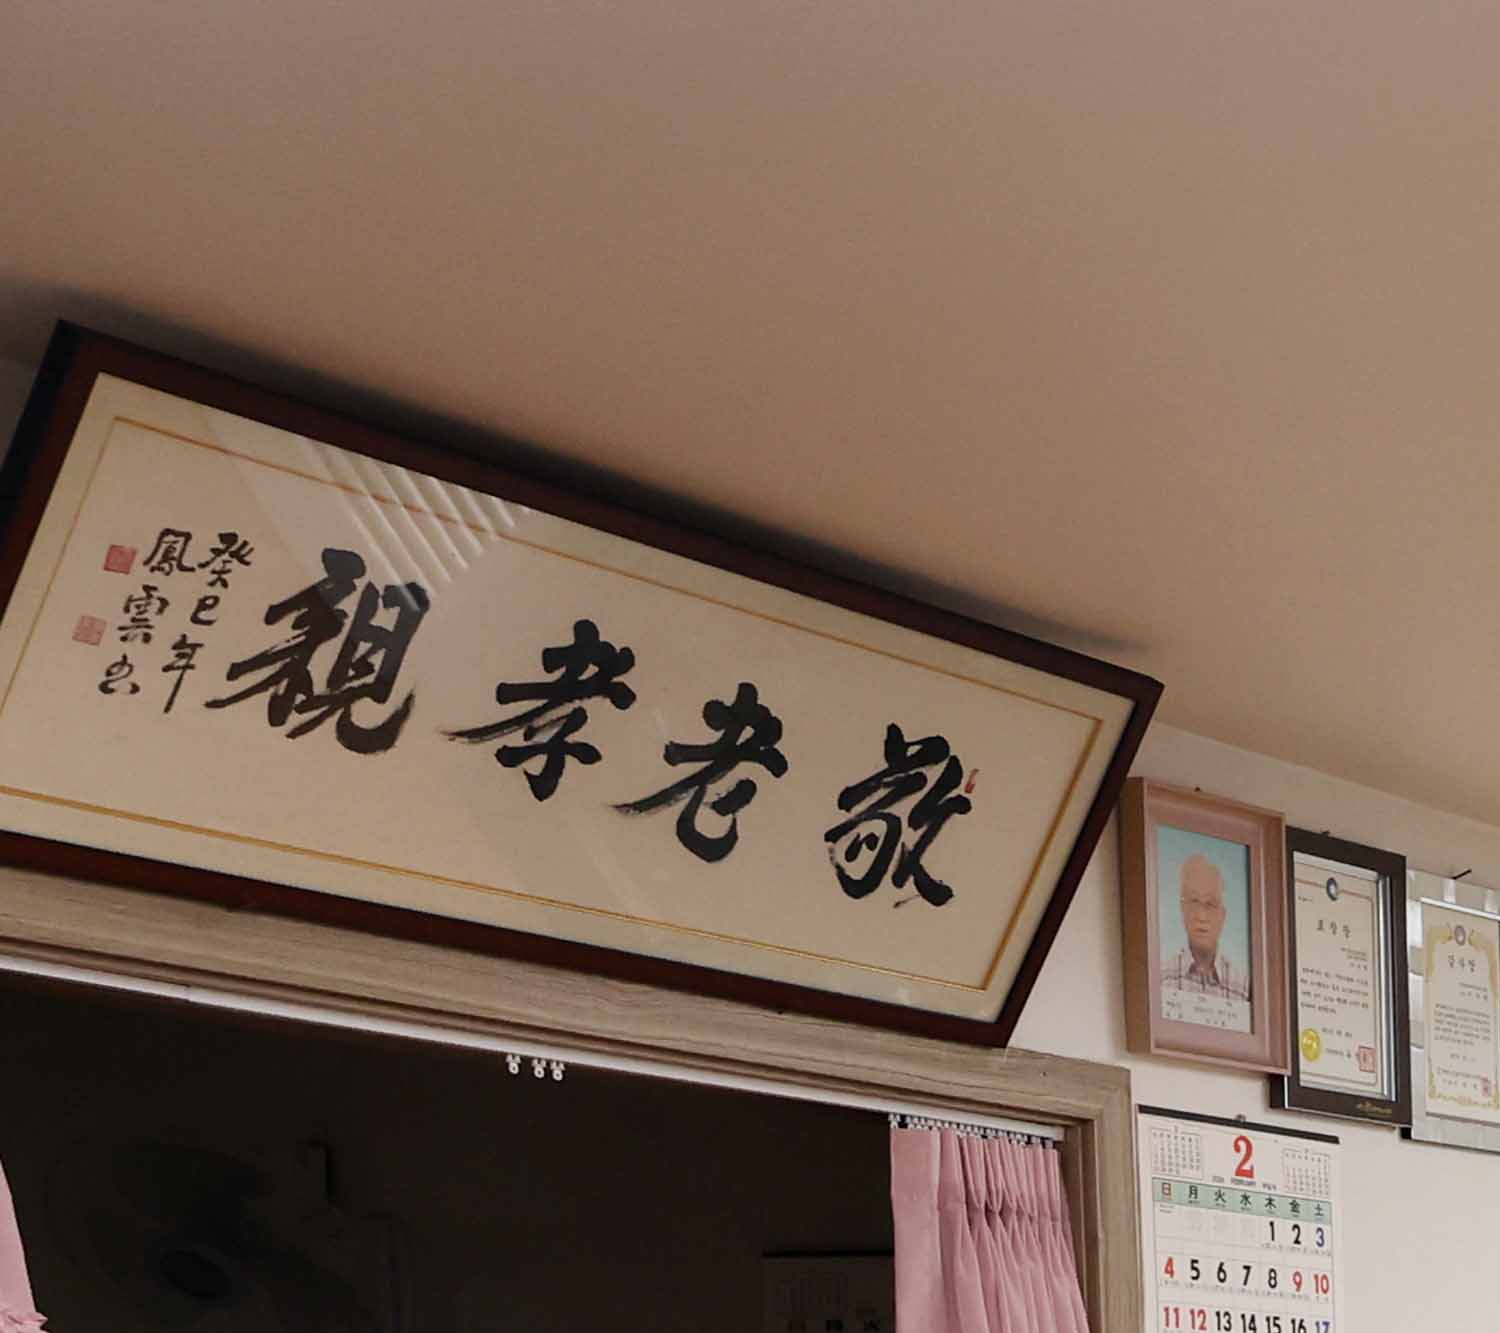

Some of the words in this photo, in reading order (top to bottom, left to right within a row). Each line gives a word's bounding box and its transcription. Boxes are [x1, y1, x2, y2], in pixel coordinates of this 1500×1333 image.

[1233, 1135, 1255, 1178] 2
[1162, 1183, 1172, 1197] 日
[1188, 1185, 1198, 1200] 月
[1214, 1189, 1226, 1203] 火
[1240, 1192, 1252, 1206] 水
[1264, 1196, 1276, 1210] 木
[1289, 1199, 1301, 1213] 金
[1314, 1203, 1325, 1216] 土
[1269, 1221, 1275, 1242] 1
[1291, 1224, 1302, 1245] 2
[1315, 1227, 1325, 1247] 3
[1164, 1257, 1175, 1278] 4
[1190, 1259, 1200, 1280] 5
[1216, 1262, 1227, 1283] 6
[1242, 1265, 1252, 1286] 7
[1268, 1268, 1278, 1289] 8
[1292, 1271, 1303, 1292] 9
[1313, 1274, 1329, 1294] 10
[1163, 1306, 1180, 1328] 11
[1189, 1309, 1208, 1331] 12
[1215, 1311, 1232, 1332] 13
